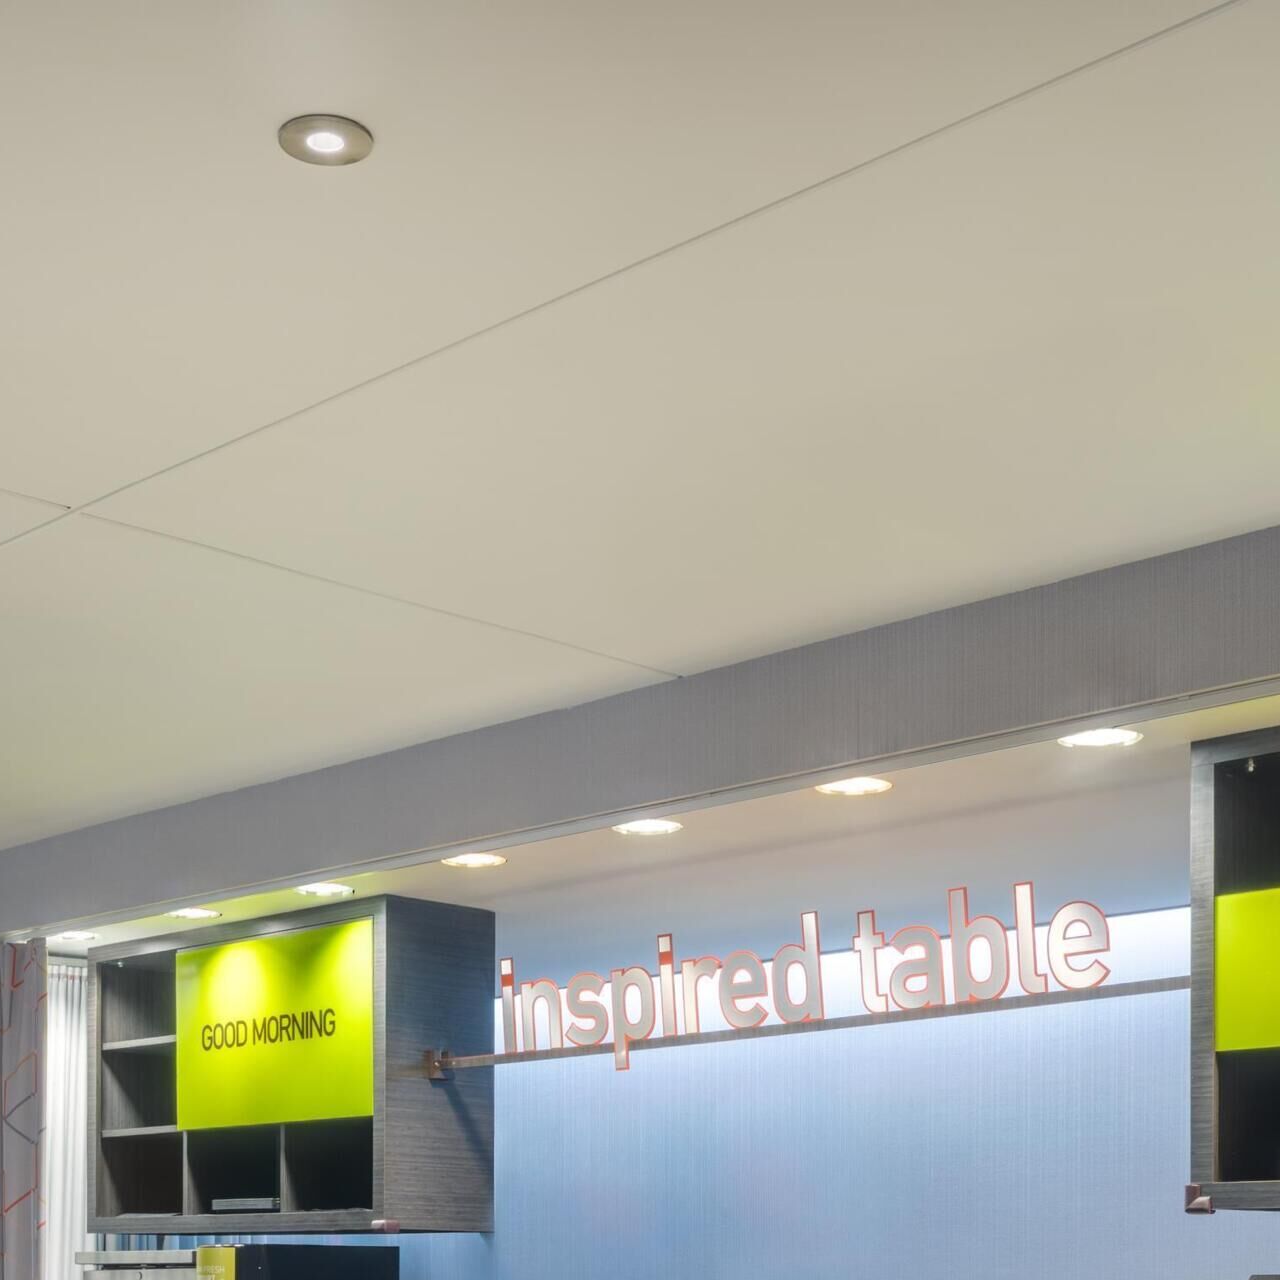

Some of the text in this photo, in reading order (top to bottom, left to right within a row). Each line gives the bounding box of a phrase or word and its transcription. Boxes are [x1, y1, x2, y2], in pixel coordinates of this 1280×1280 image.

[201, 1008, 336, 1051] GOOD MORNING
[500, 881, 1111, 1070] inspired table
